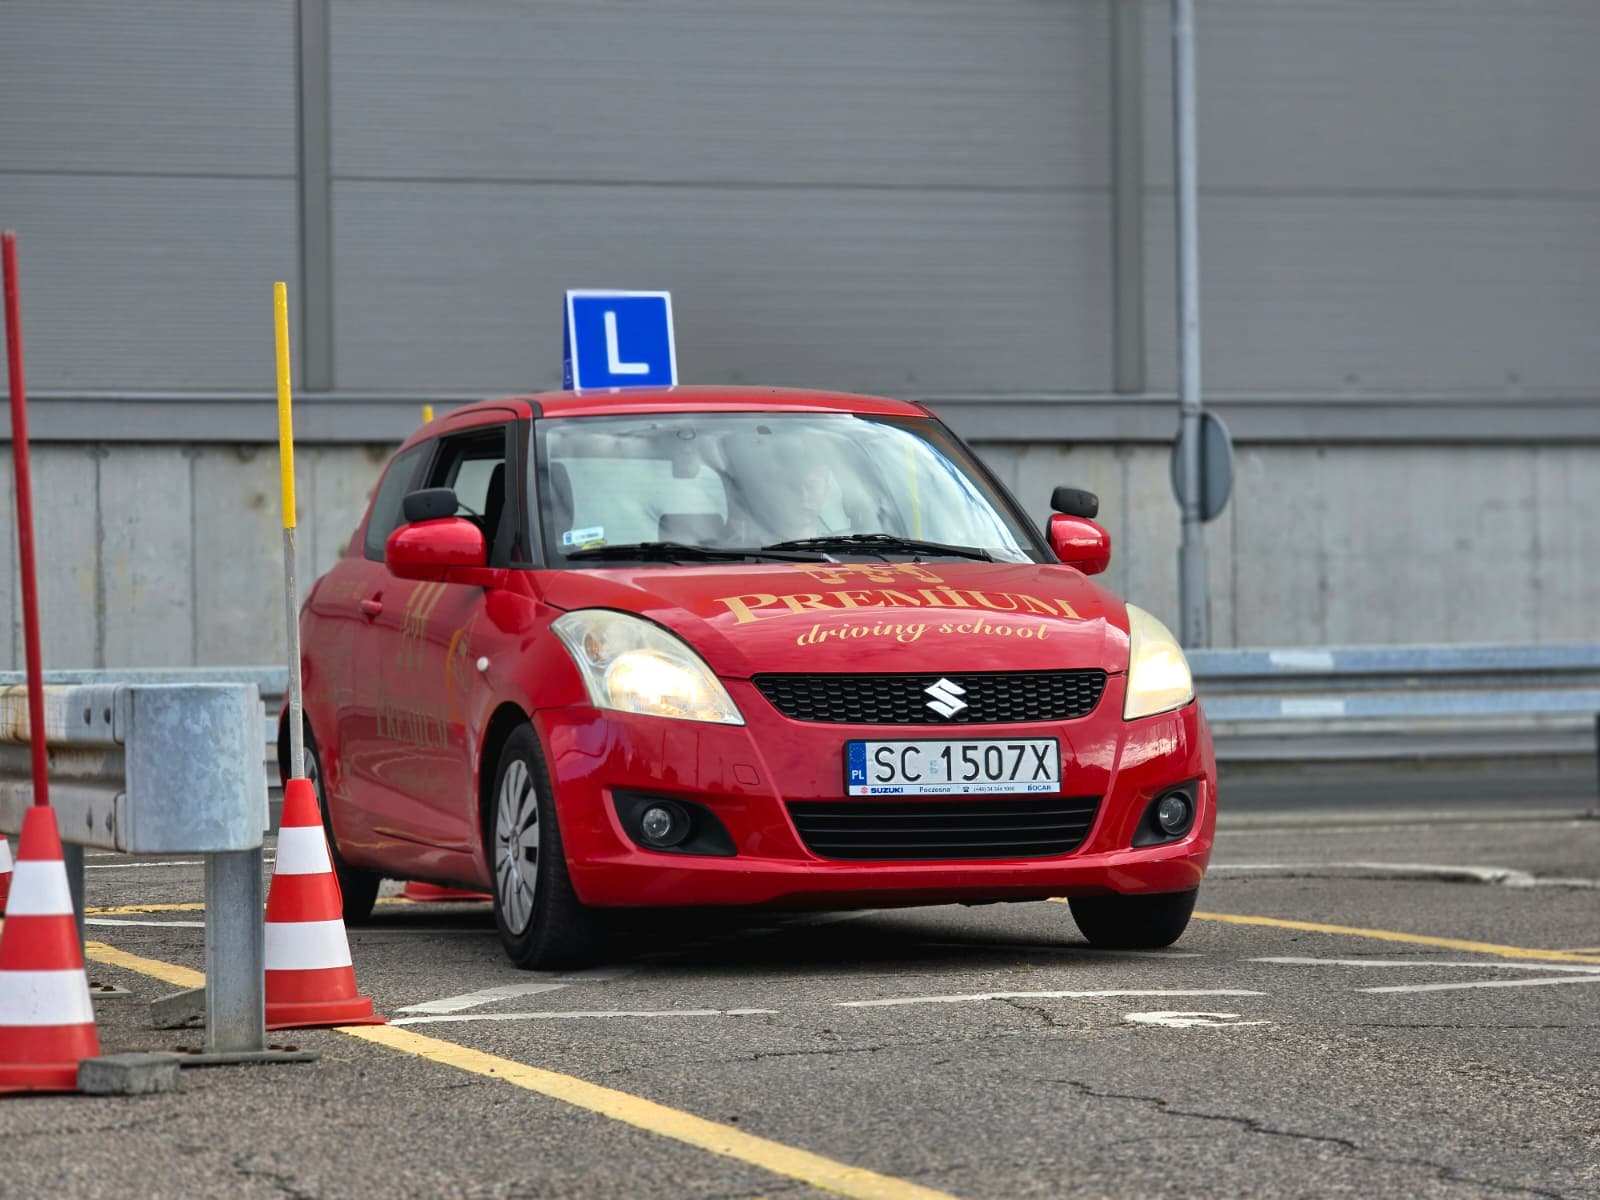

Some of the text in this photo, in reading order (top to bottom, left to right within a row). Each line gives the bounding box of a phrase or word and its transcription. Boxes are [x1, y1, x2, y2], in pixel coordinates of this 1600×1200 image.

[604, 311, 650, 374] L
[712, 585, 1088, 626] PREMIUM
[796, 618, 1051, 646] driving school
[851, 770, 865, 780] PL
[874, 744, 1052, 783] SC 1507X
